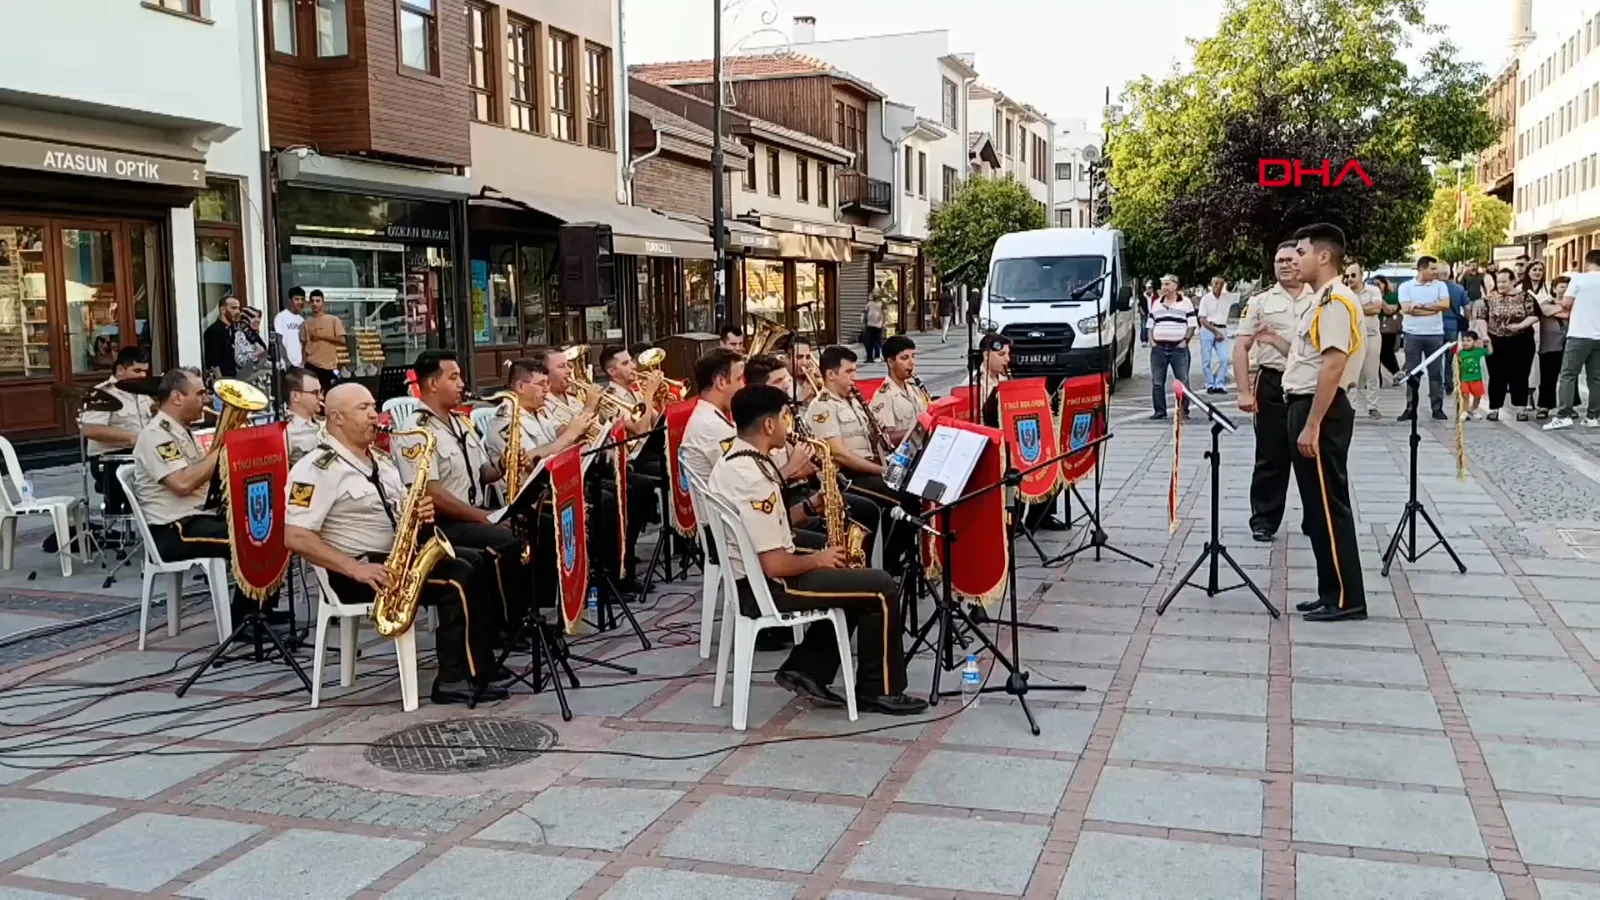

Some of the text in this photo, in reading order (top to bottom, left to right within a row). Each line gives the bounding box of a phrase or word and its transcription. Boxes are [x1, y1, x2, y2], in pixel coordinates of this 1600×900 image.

[43, 150, 159, 180] ATASUN OPTİK
[192, 169, 200, 181] 2
[387, 222, 420, 238] ÖZKAN
